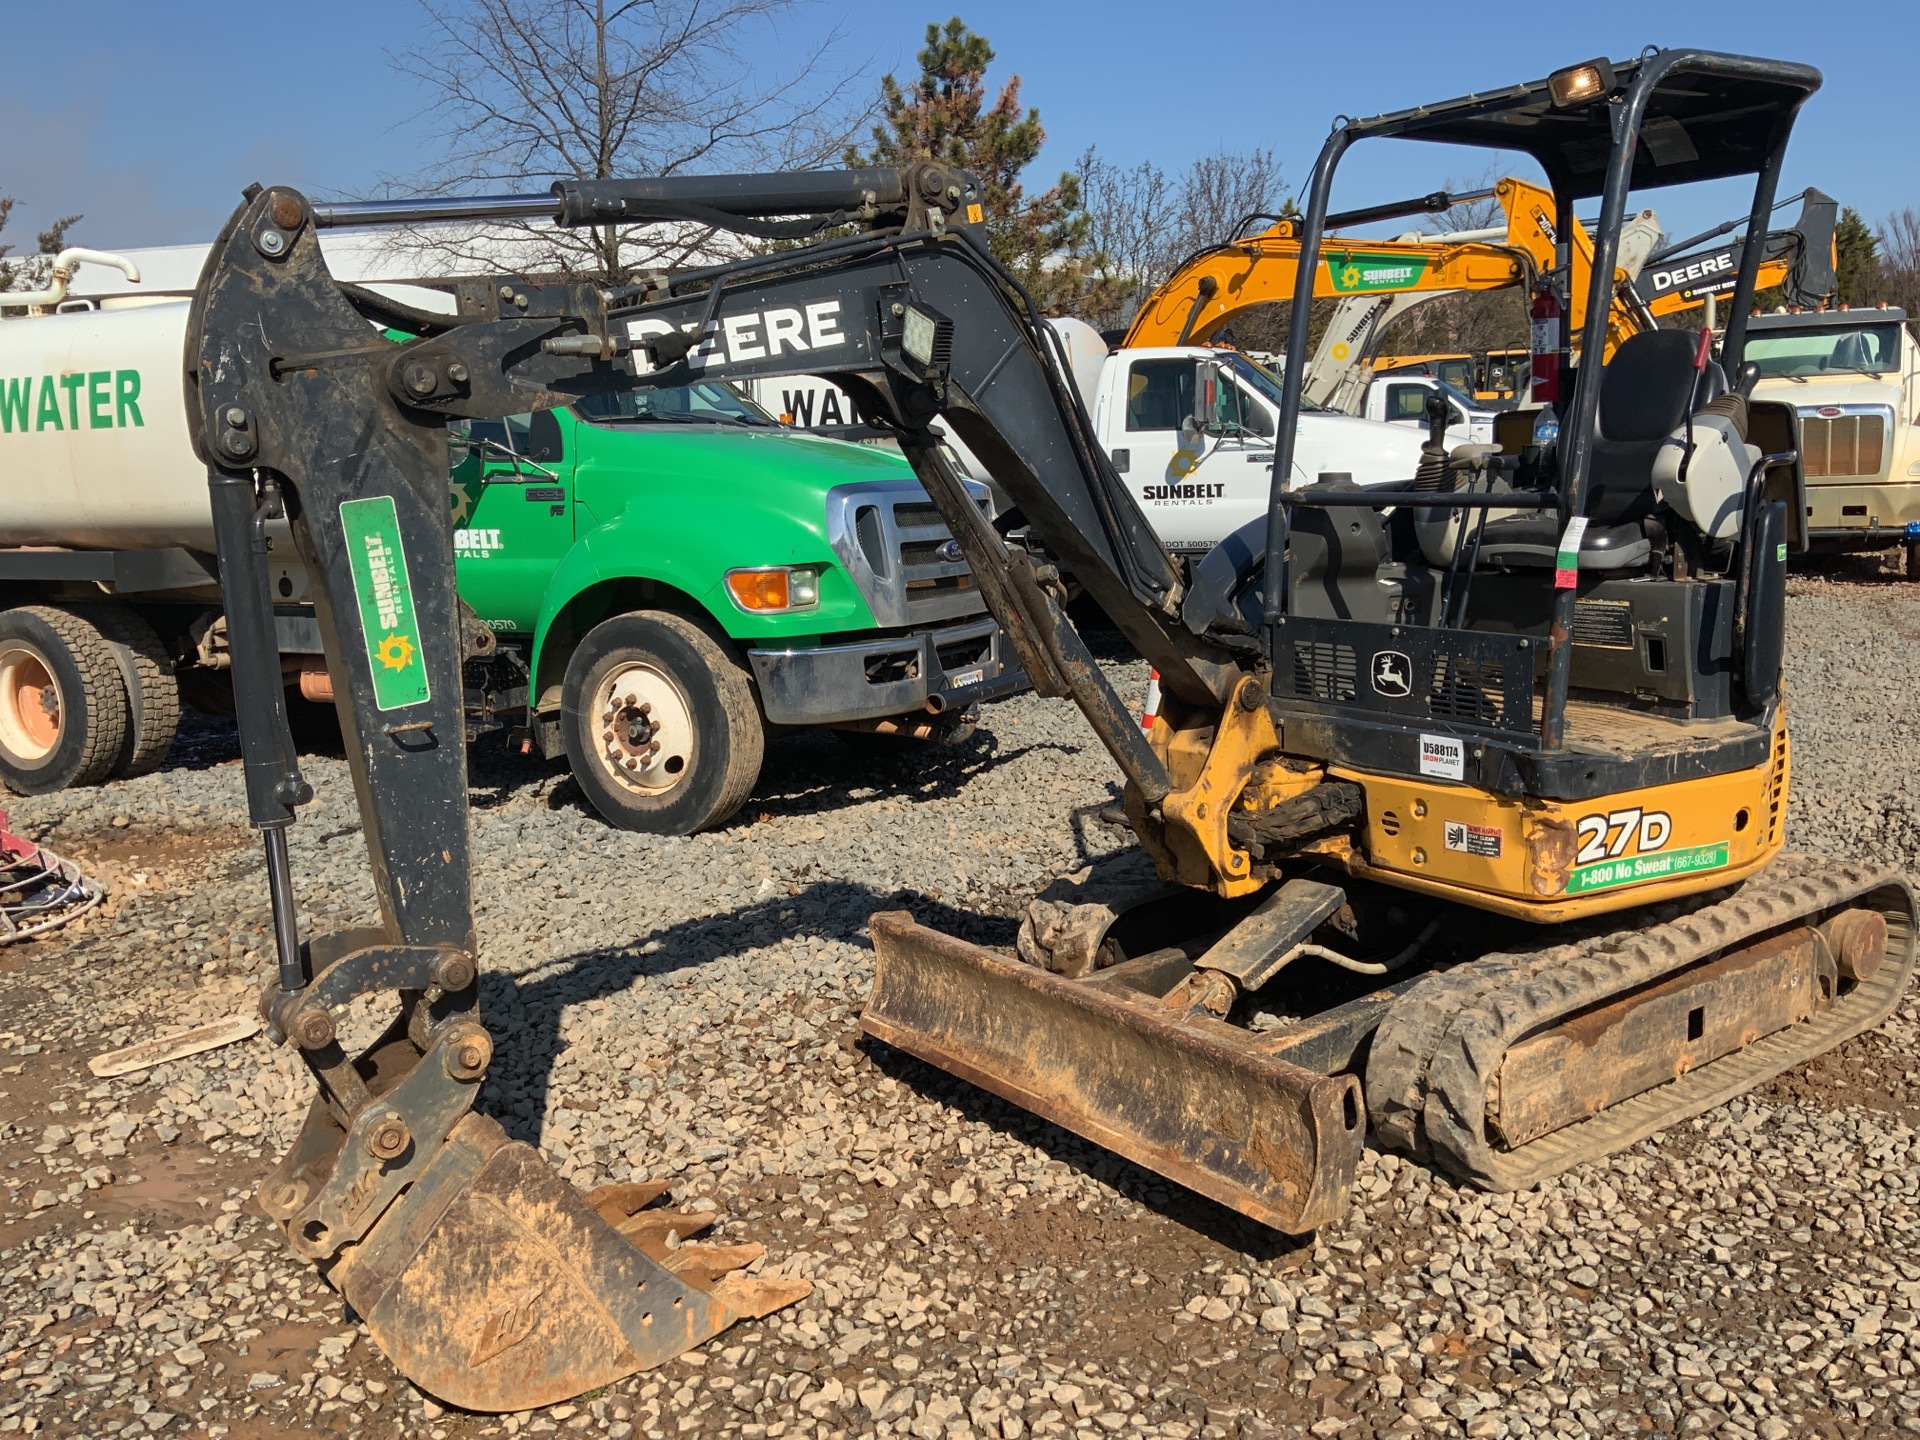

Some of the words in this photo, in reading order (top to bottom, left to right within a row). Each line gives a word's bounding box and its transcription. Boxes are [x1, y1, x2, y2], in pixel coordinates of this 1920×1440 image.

[1363, 267, 1413, 282] SUNBELT
[1652, 253, 1734, 291] DEERE
[1692, 284, 1721, 296] SUNBELT
[1346, 304, 1377, 344] SUNBELT
[626, 301, 845, 378] DEERE
[0, 369, 145, 433] WATER
[1143, 484, 1225, 500] SUNBELT
[1154, 499, 1213, 507] RENTALS
[454, 529, 500, 549] BELT
[455, 550, 490, 559] TALS
[364, 535, 399, 631] SUNBELT
[384, 546, 404, 614] RENTALS
[484, 619, 517, 630] 0570
[1423, 742, 1459, 758] U588174
[1576, 807, 1671, 866] 27D
[1580, 865, 1613, 887] 1-800
[1615, 863, 1632, 879] No
[1634, 856, 1672, 875] Sweat
[1674, 851, 1716, 871] (667-9328)
